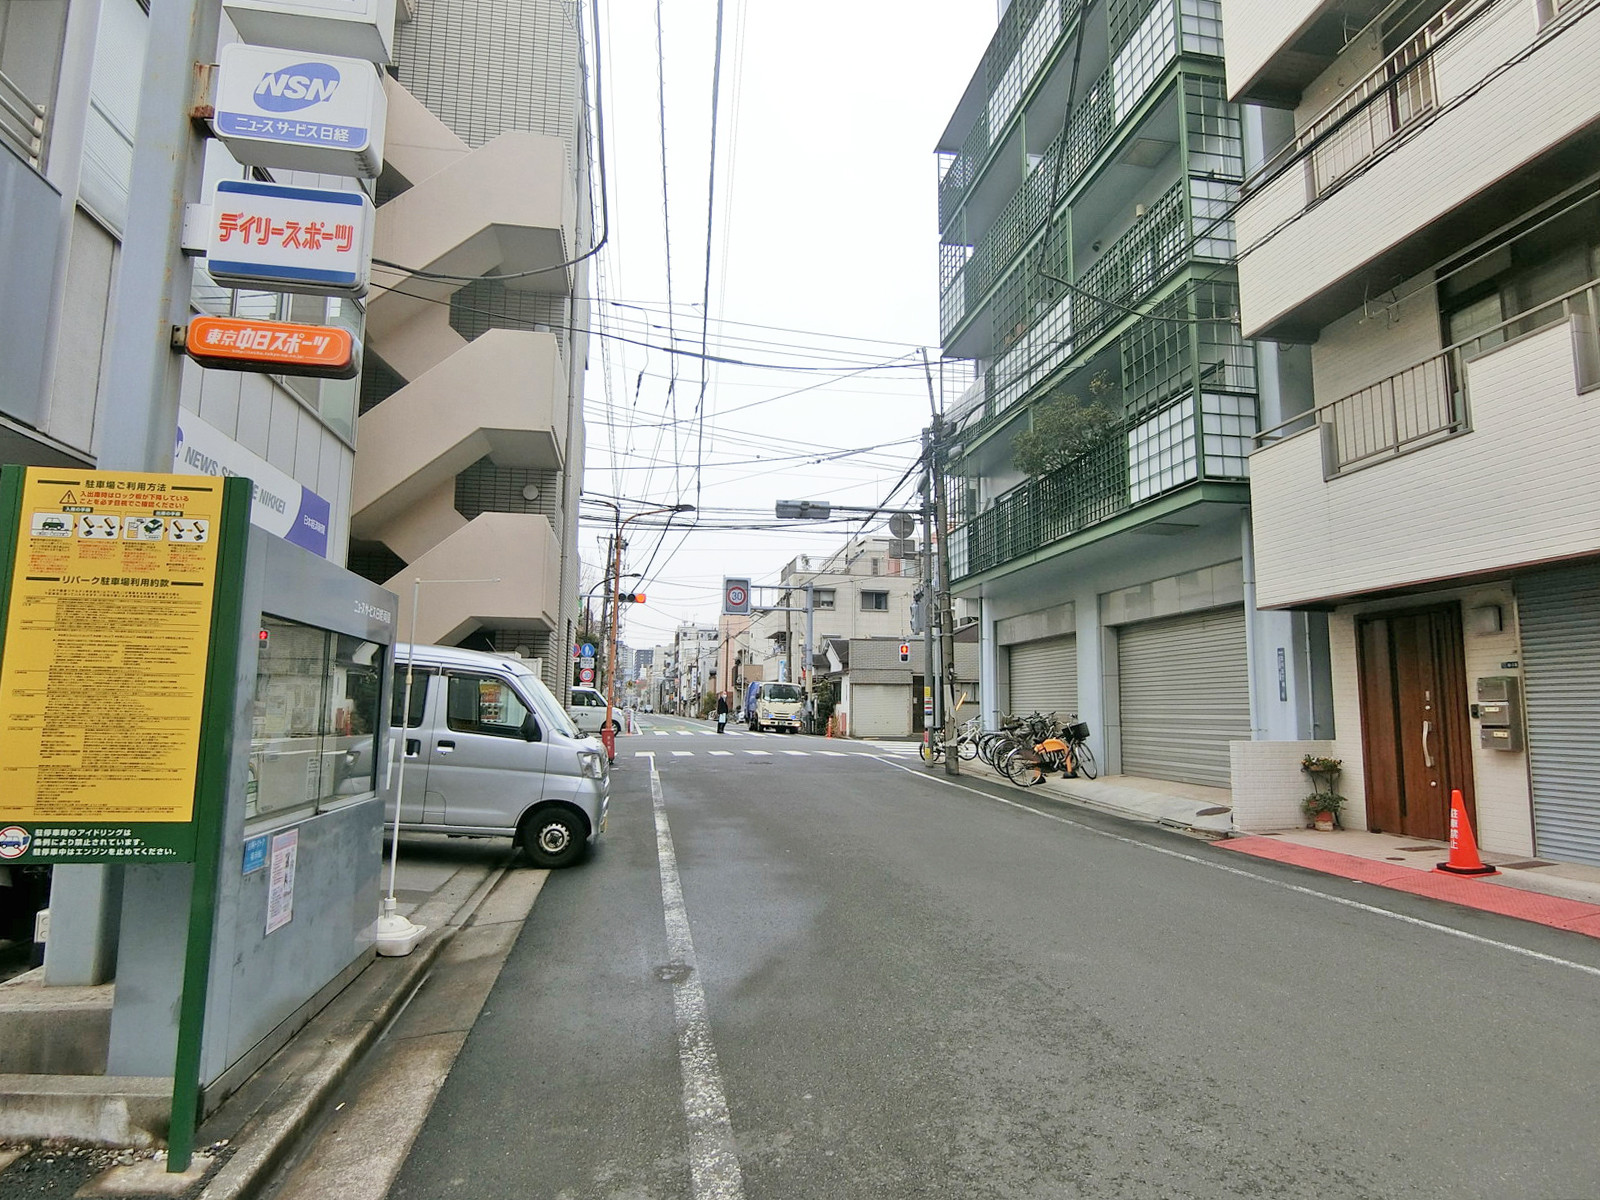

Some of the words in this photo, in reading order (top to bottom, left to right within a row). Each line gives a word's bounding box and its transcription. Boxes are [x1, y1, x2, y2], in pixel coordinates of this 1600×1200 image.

[255, 72, 339, 102] NSN
[219, 212, 353, 252] デイリースポーツ
[85, 480, 166, 492] 駐車場ご利用方法
[184, 446, 218, 476] NEWS
[259, 489, 287, 515] NIKKEI
[731, 591, 742, 601] 30
[34, 828, 131, 837] 駐停車時のアイドリングは
